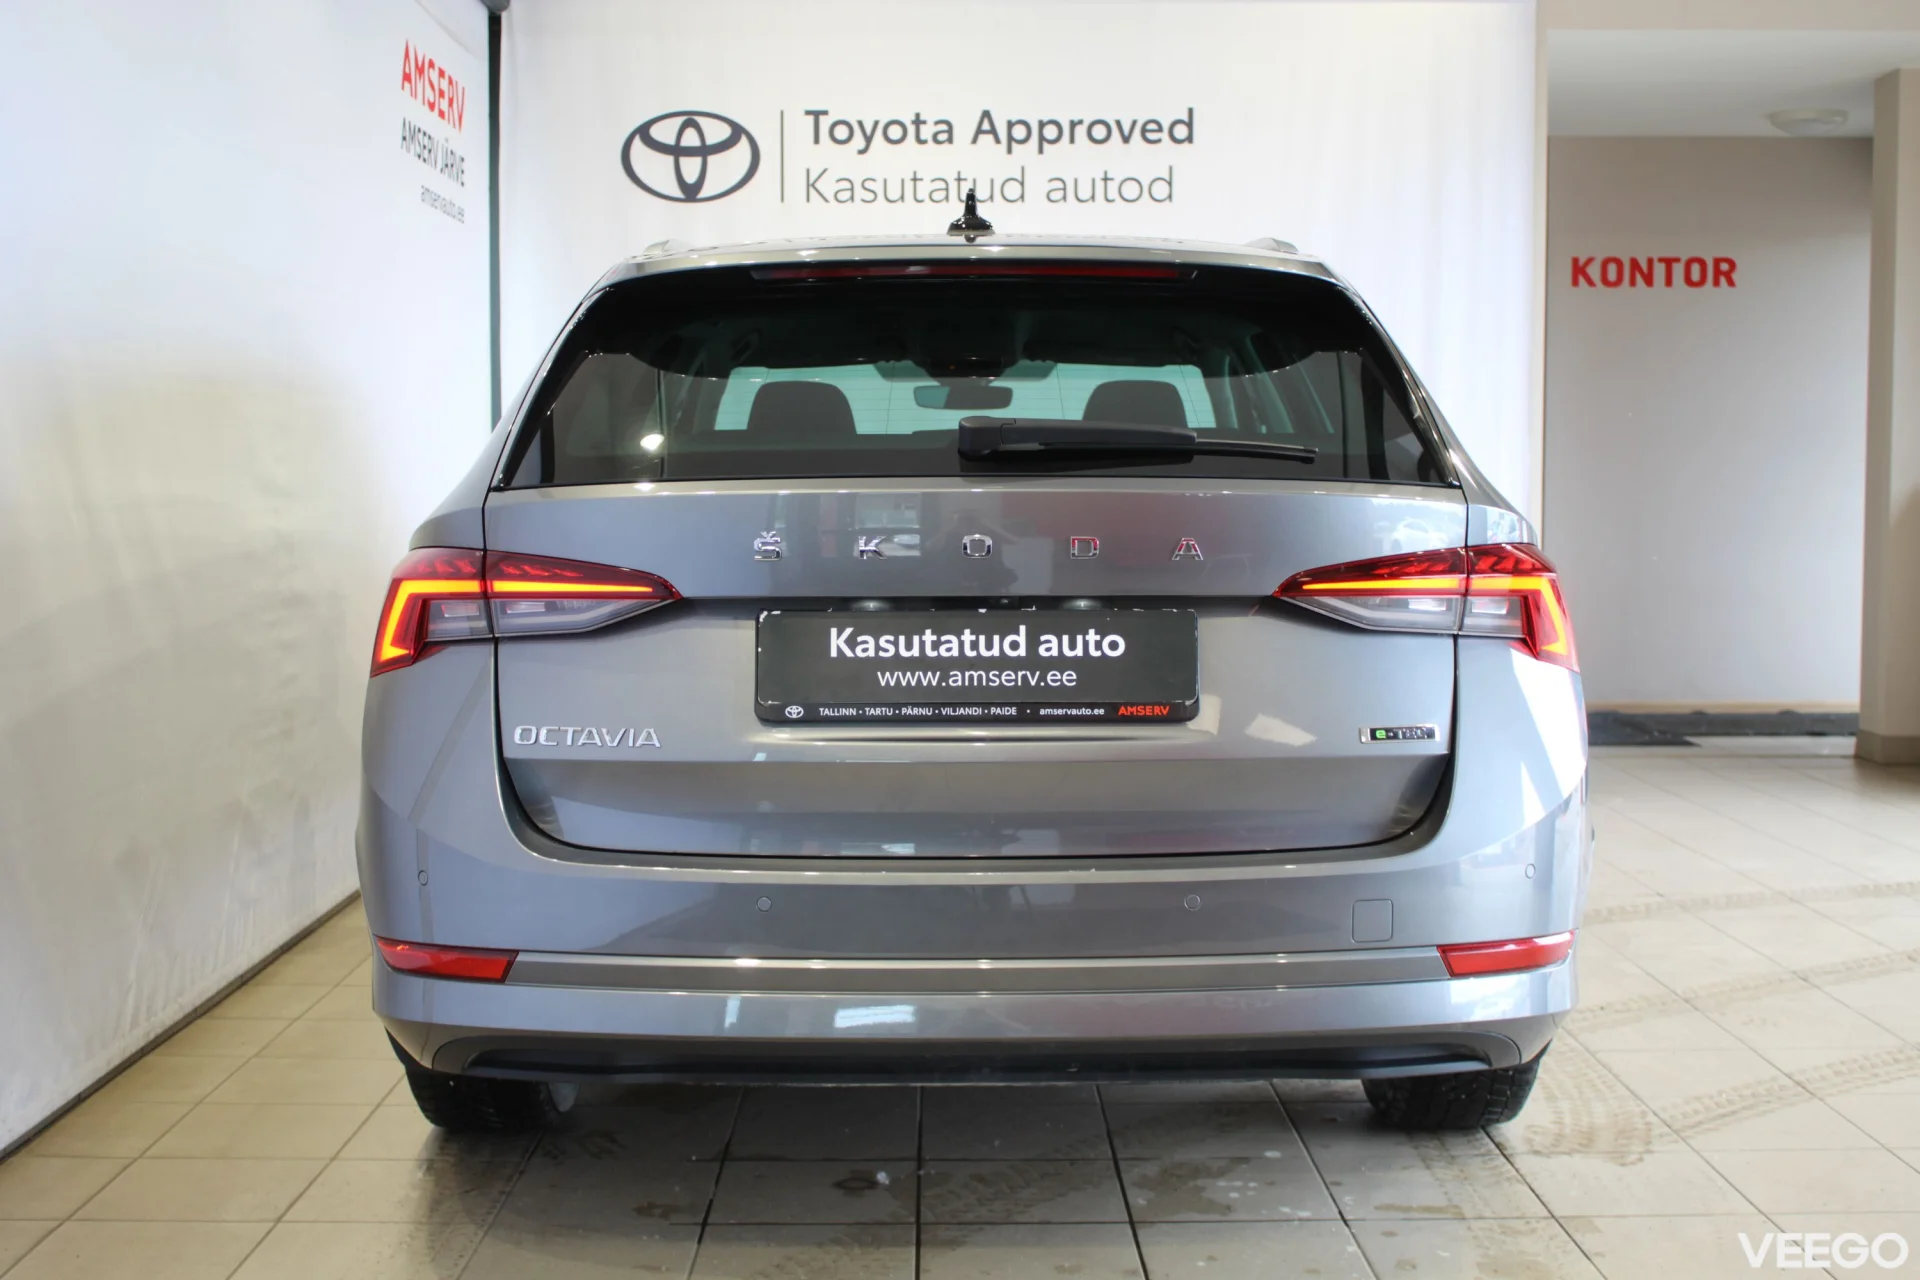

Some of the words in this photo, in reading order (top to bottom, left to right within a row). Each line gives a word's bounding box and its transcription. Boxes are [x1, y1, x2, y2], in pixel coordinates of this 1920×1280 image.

[401, 38, 465, 134] AMSERV
[804, 109, 954, 155] Toyota
[970, 107, 1194, 155] Approved
[401, 117, 440, 171] AMSERV
[440, 137, 465, 188] JÄRVE
[805, 165, 1026, 203] Kasutatud
[1046, 165, 1174, 203] autod
[1571, 256, 1737, 288] KONTOR
[754, 531, 1203, 561] ŠKODA
[829, 625, 1026, 658] Kasutatud
[1038, 629, 1126, 658] auto
[877, 669, 1077, 687] www.amserv.ee
[819, 707, 857, 716] TALLINN
[865, 707, 893, 716] TARTU
[901, 705, 933, 716] PÄRNU
[941, 707, 982, 716] VILJANDI
[990, 707, 1017, 716] PAIDE
[1039, 707, 1105, 716] amservauto.ee
[1118, 705, 1170, 716] AMSERV
[513, 725, 661, 748] OCTAVIA
